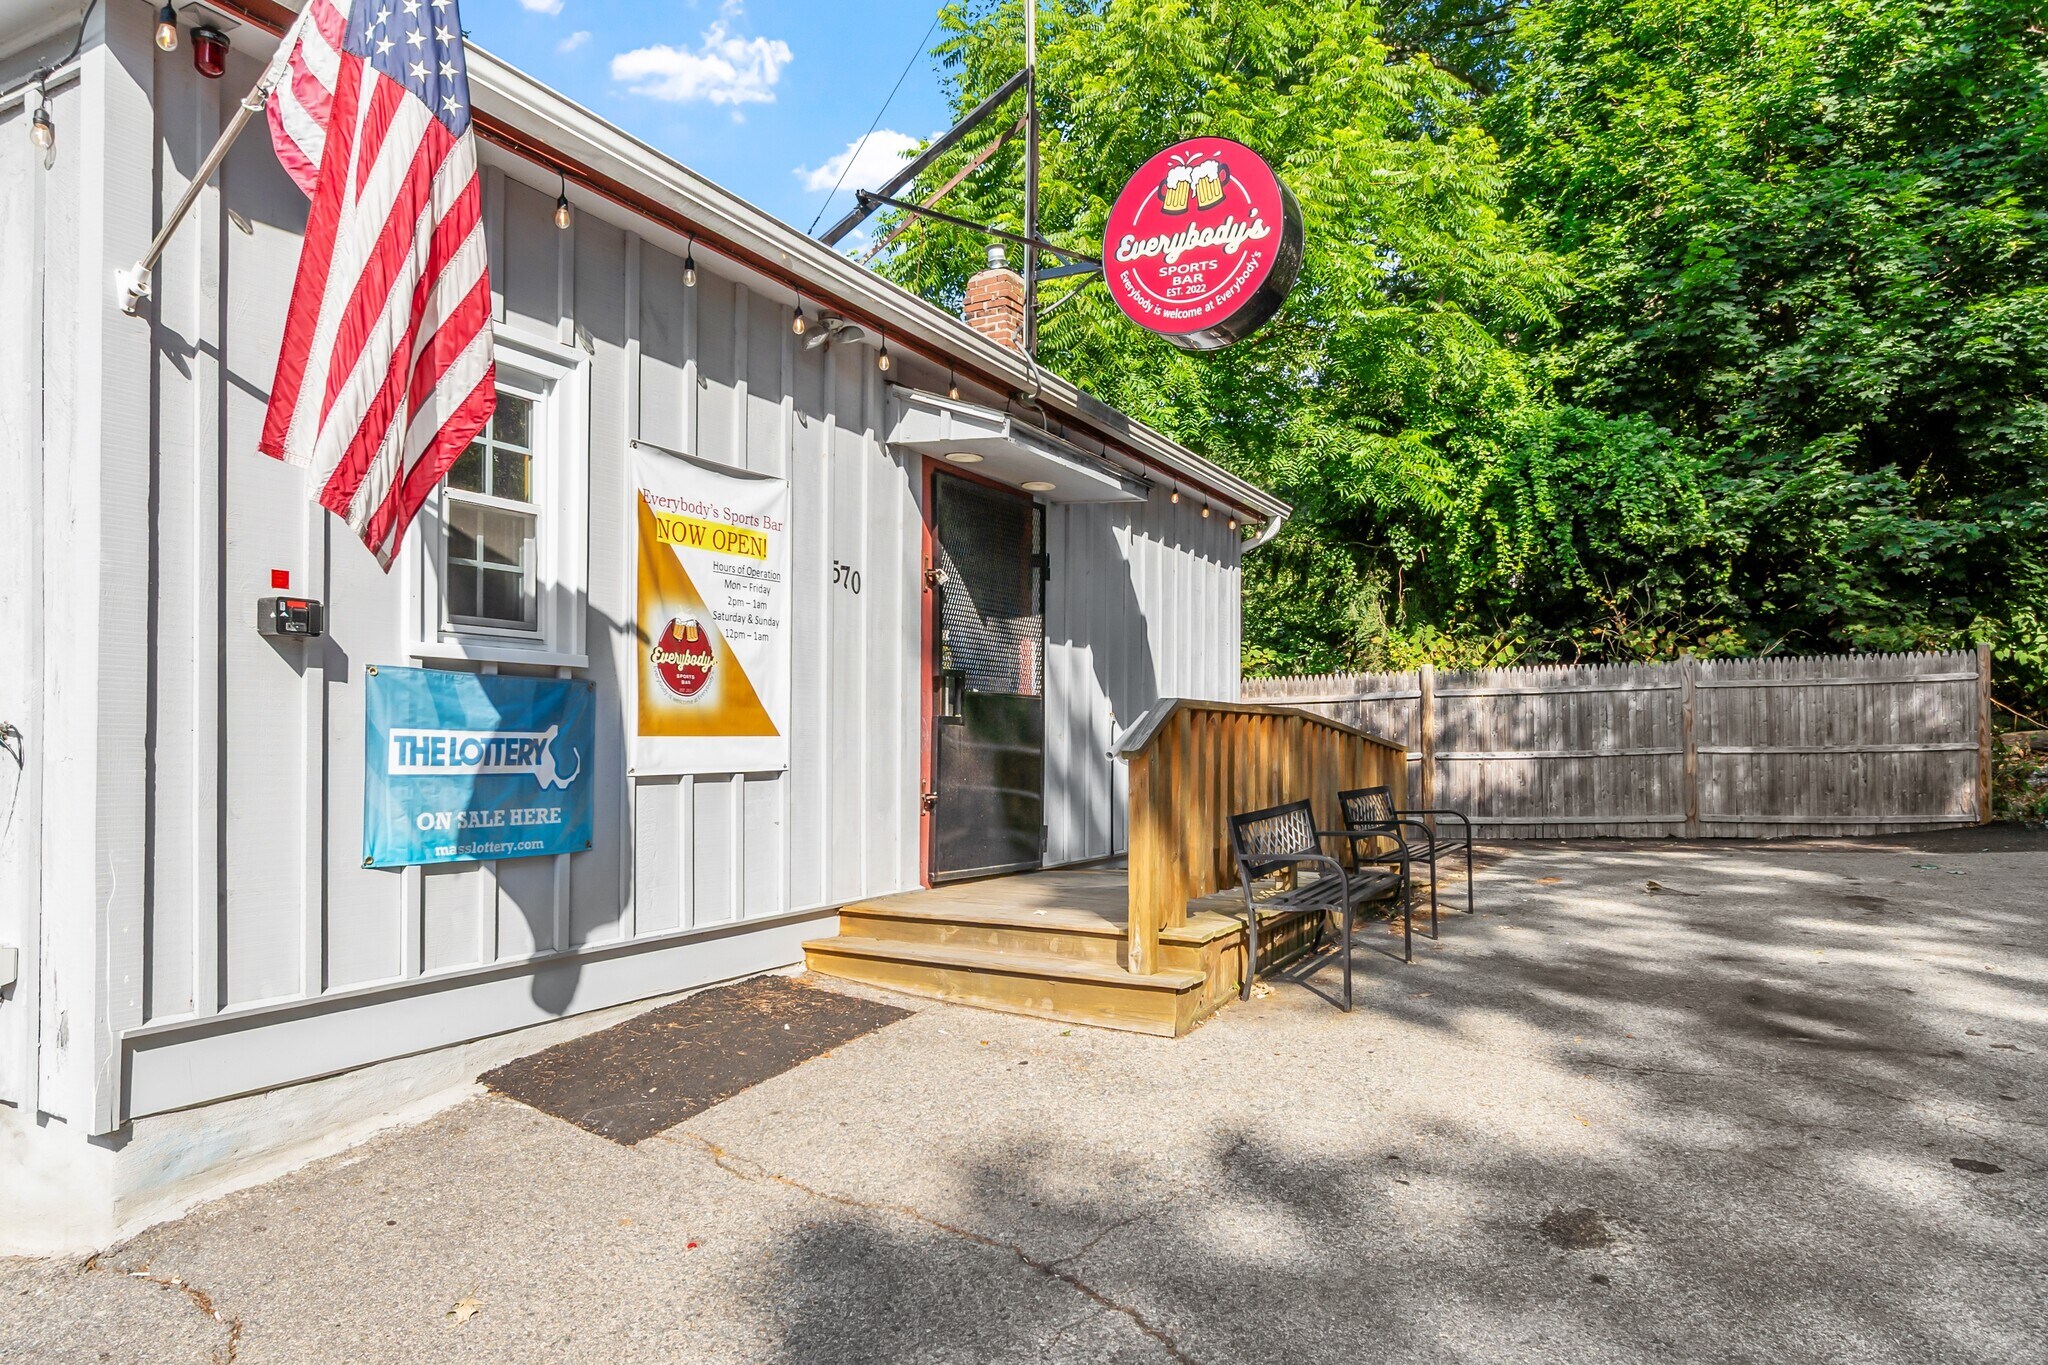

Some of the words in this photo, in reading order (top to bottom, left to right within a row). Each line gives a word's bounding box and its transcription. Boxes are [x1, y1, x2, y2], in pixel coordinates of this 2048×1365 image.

[1115, 207, 1271, 264] Everybody's
[1158, 259, 1218, 277] SPORTS
[1119, 270, 1154, 313] Everybody
[1154, 304, 1162, 316] is
[1163, 306, 1202, 319] welcome
[1204, 300, 1215, 312] at
[1215, 250, 1262, 306] Everybody's
[1172, 273, 1203, 286] BAR
[1166, 285, 1183, 297] EST.
[1185, 283, 1206, 295] 2022
[642, 488, 719, 519] Everybody's
[723, 506, 760, 526] Sports
[763, 515, 783, 532] Bar
[657, 517, 706, 546] NOW
[712, 529, 767, 558] OPEN!
[713, 561, 736, 574] Hours
[737, 564, 745, 575] of
[746, 566, 781, 581] Operation
[833, 560, 861, 595] 570
[724, 579, 741, 591] Mon
[749, 581, 771, 596] Friday
[727, 596, 745, 608] 2pm
[753, 599, 767, 610] 1am
[713, 611, 746, 625] Saturday
[747, 614, 754, 624] &
[755, 616, 780, 628] Sunday
[725, 628, 747, 641] 12pm
[754, 630, 769, 641] 1am
[393, 735, 446, 767] THE
[450, 736, 549, 767] LOTTERY
[416, 811, 452, 831] ON
[457, 808, 506, 829] SALE
[510, 807, 562, 826] HERE
[435, 839, 545, 857] masslottery.com
